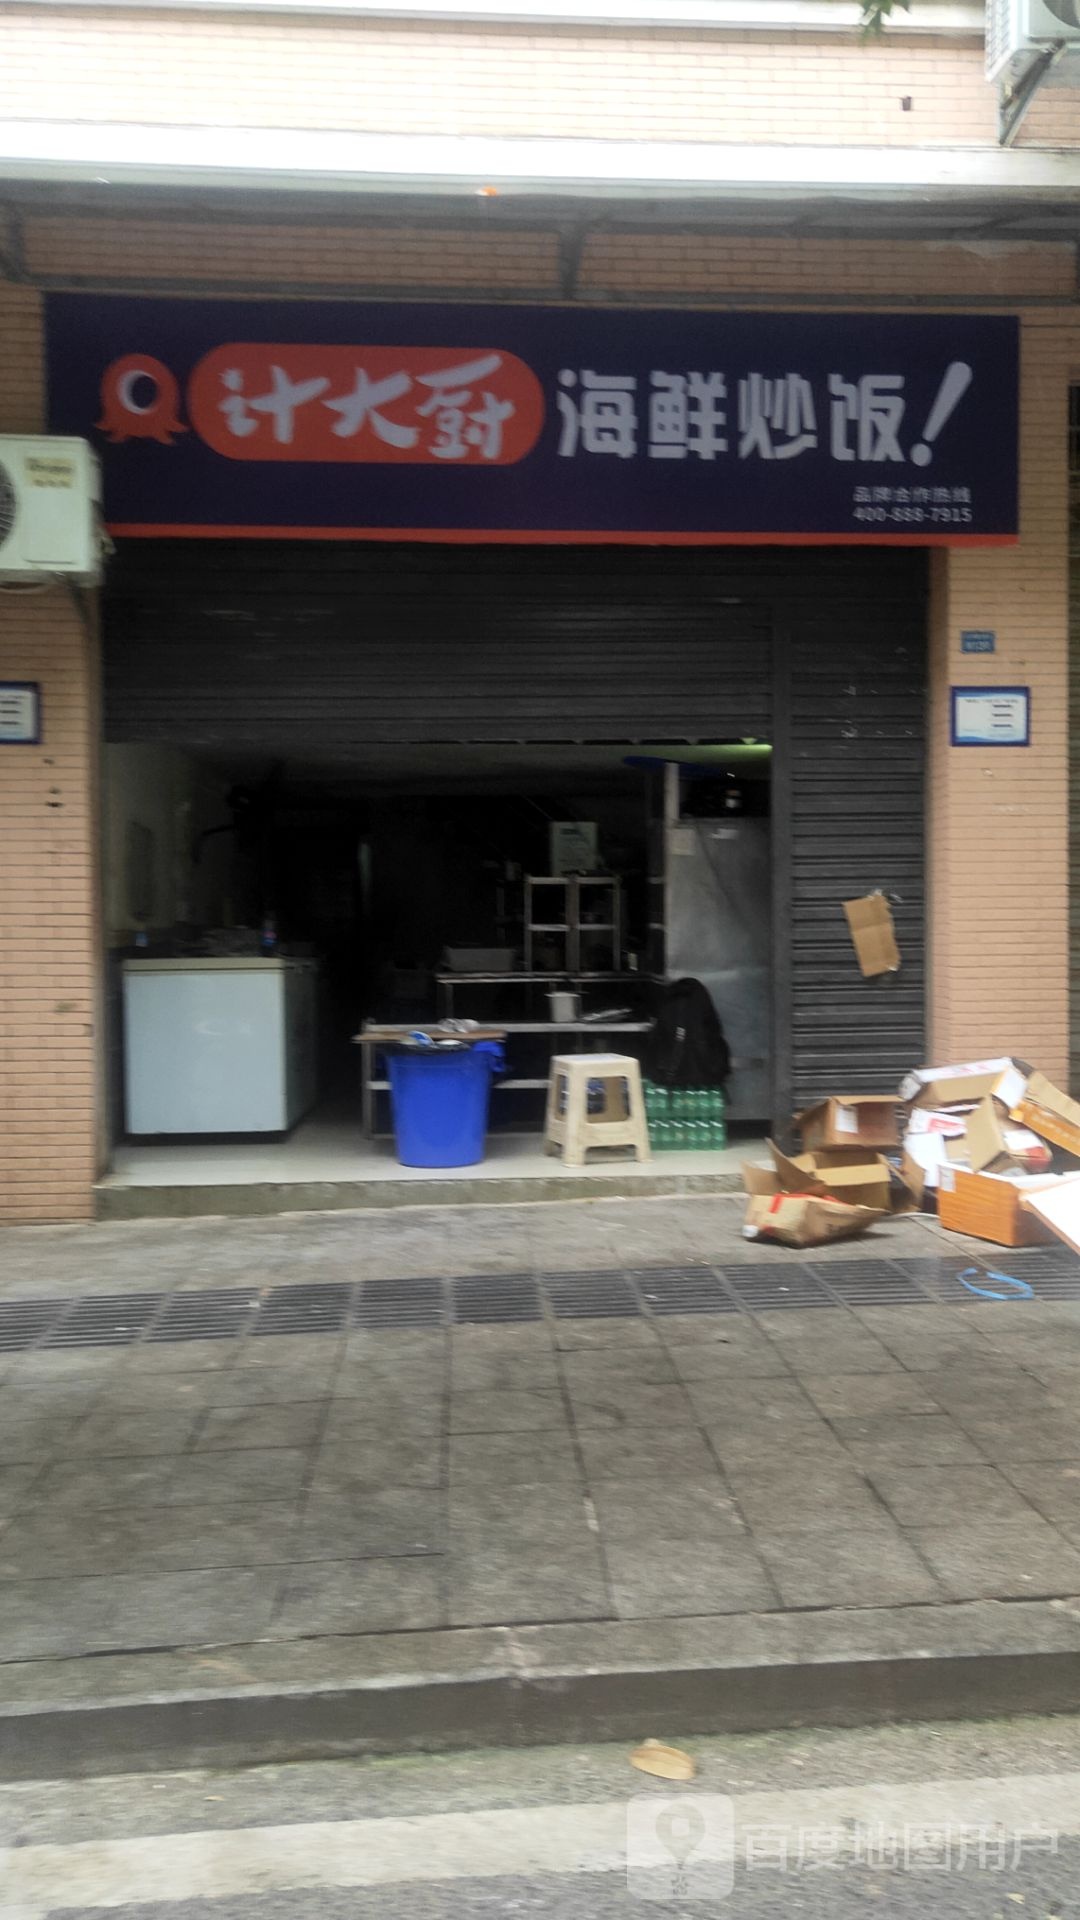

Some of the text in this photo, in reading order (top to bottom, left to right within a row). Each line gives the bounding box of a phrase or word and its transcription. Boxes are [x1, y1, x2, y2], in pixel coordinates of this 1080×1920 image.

[853, 486, 971, 503] 品牌合作热线
[853, 507, 973, 522] 400-888-7915
